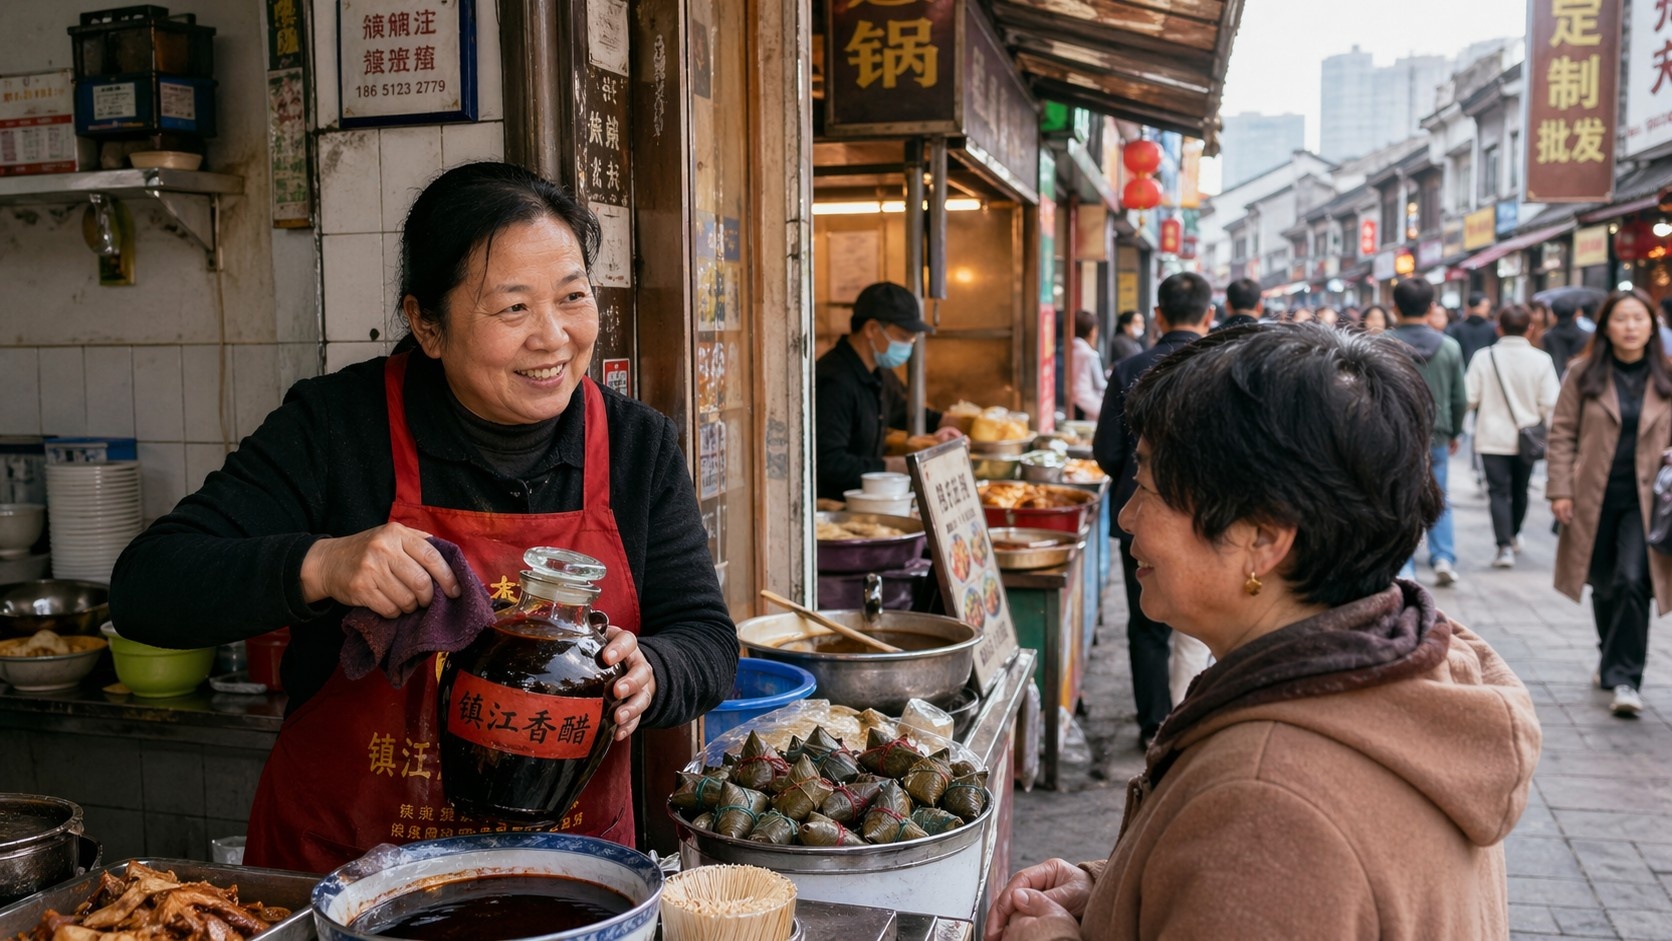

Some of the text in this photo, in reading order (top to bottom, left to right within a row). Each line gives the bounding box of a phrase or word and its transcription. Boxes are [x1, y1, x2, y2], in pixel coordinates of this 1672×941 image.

[844, 0, 939, 89] 锅
[1547, 0, 1603, 110] 定制
[356, 80, 446, 98] 186 5123 2779
[1536, 117, 1606, 164] 批发
[458, 690, 591, 745] 镇江香醋
